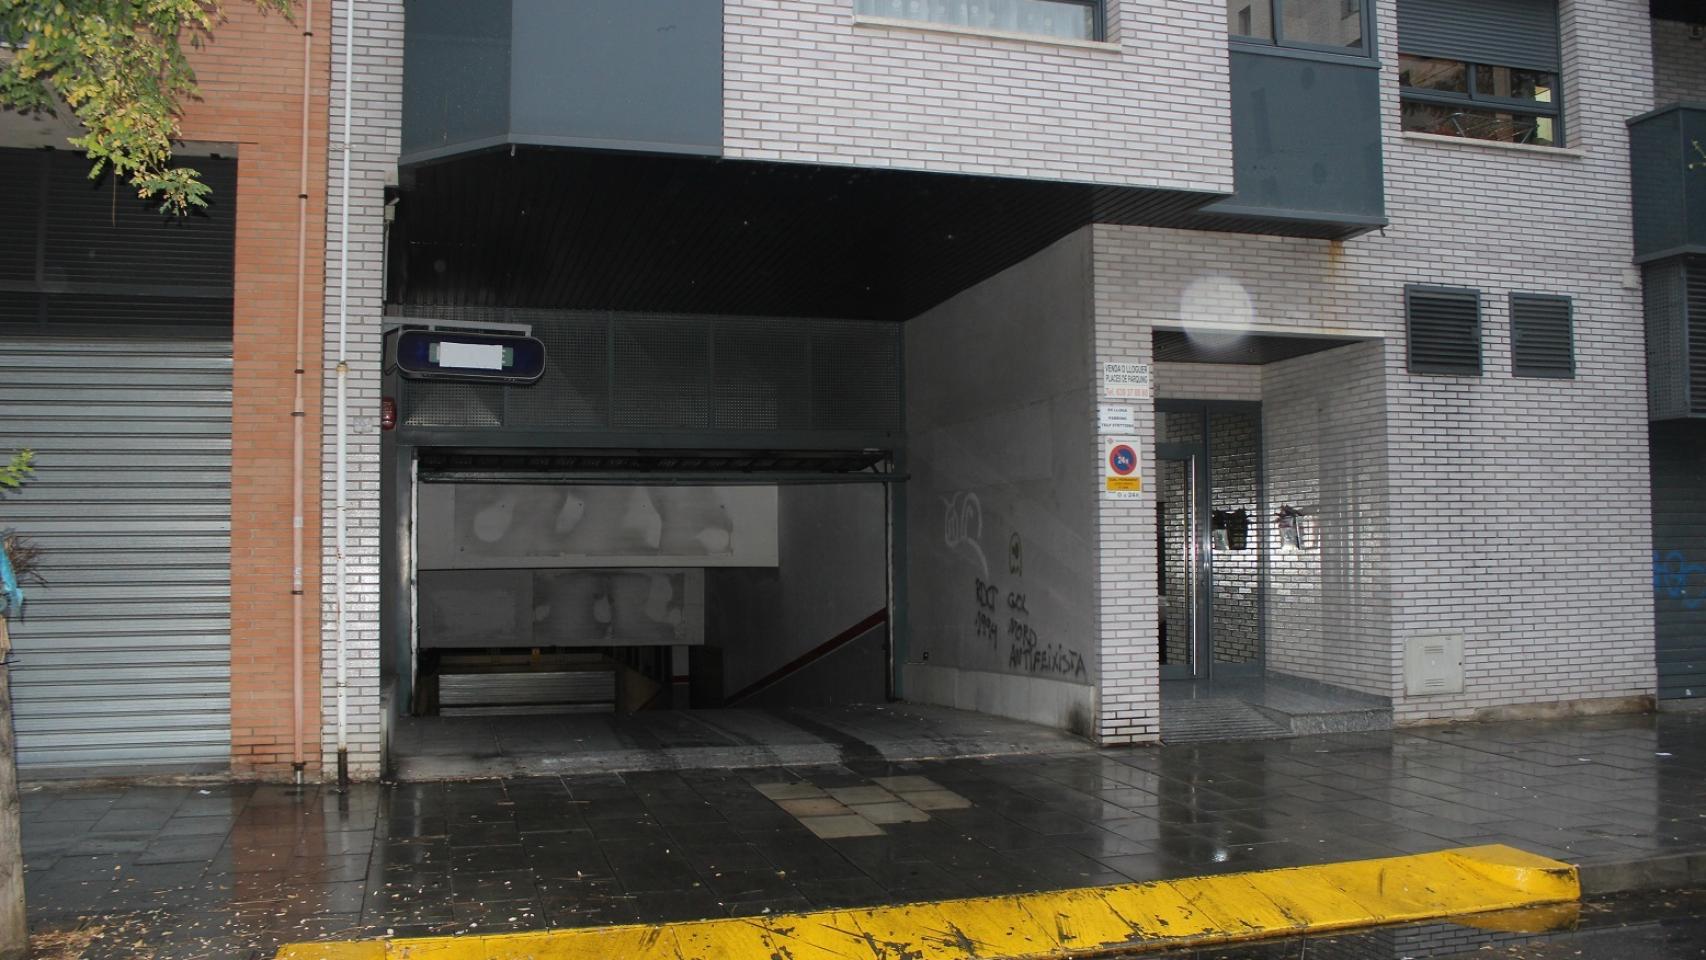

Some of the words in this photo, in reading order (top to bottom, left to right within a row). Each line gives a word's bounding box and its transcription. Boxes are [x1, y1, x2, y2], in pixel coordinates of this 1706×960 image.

[1105, 364, 1120, 373] VENDA
[1126, 365, 1147, 374] LLOGUER
[1105, 374, 1120, 383] PLACES
[1121, 374, 1127, 383] DE
